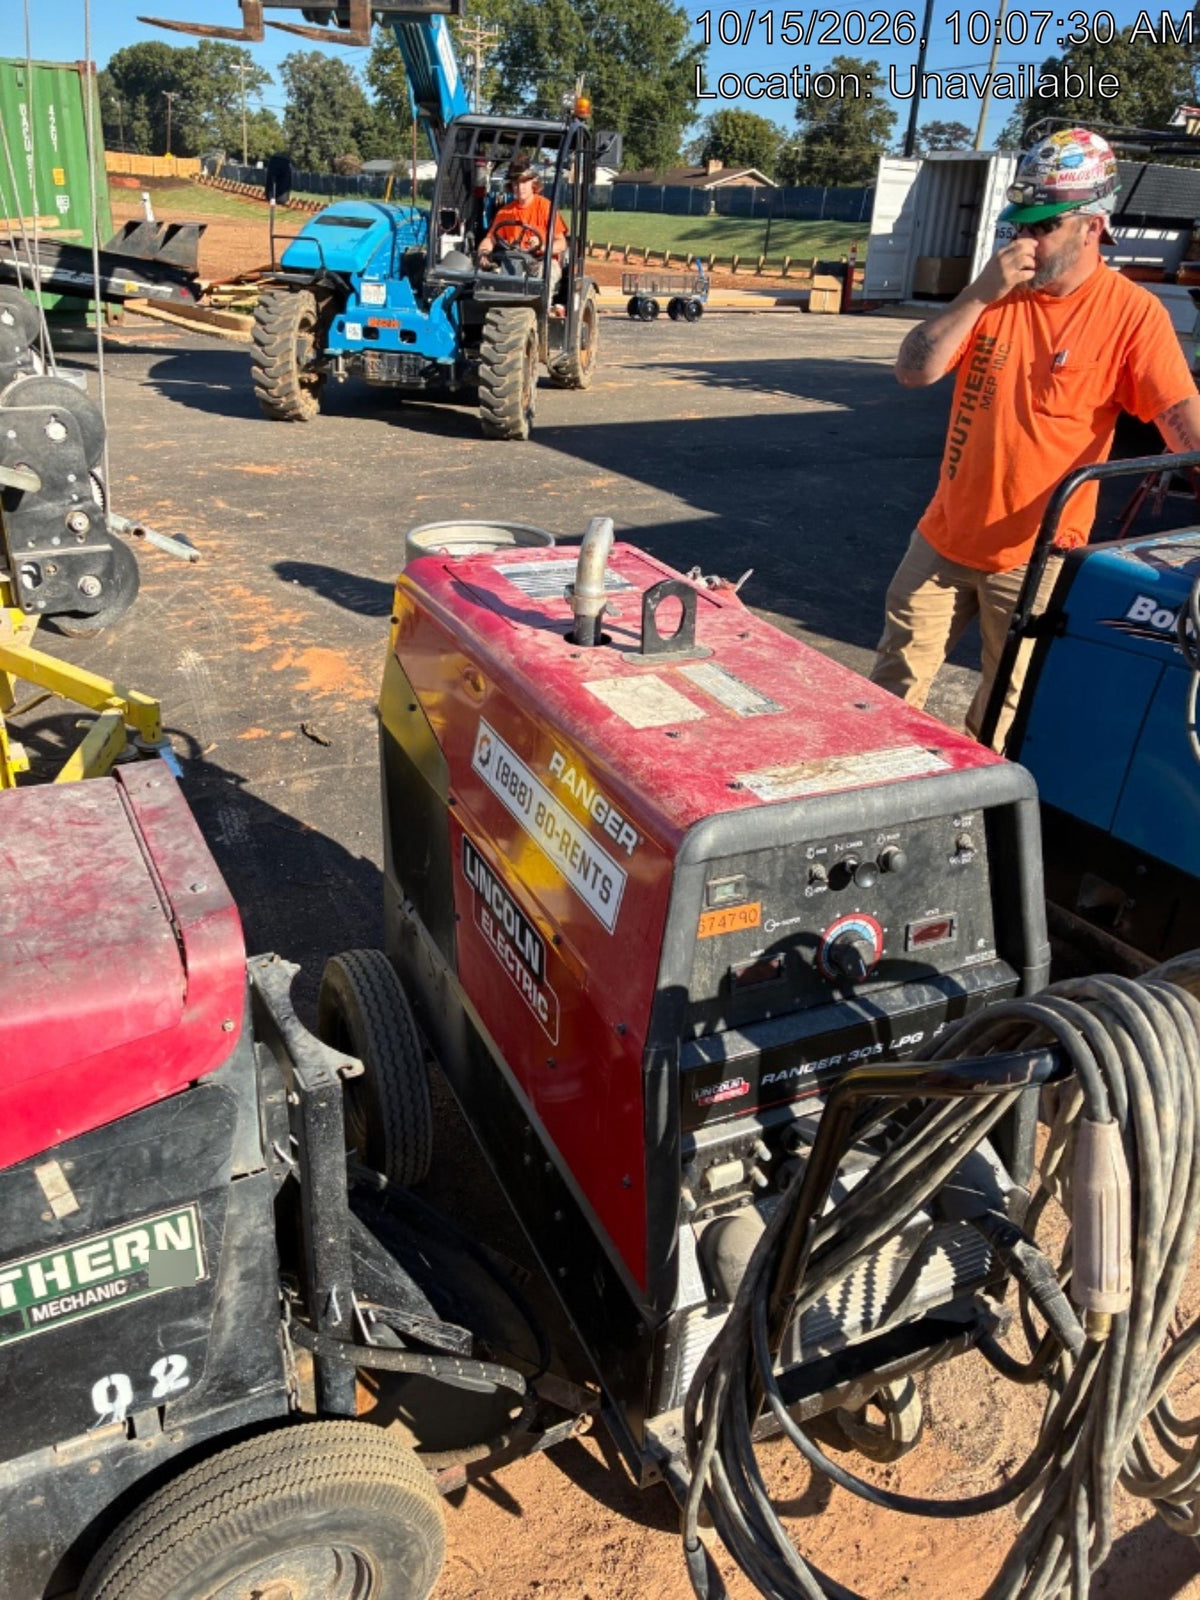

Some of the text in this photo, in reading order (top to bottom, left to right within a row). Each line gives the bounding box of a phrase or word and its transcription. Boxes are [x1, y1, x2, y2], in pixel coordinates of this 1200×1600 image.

[980, 377, 998, 410] MEP
[495, 754, 613, 904] (888) 80-RENTS
[548, 750, 639, 856] RANGER
[465, 845, 541, 976] LINCOLN
[480, 907, 549, 1024] ELECTRIC
[760, 1055, 842, 1086] RANGER
[889, 1030, 924, 1050] LPG
